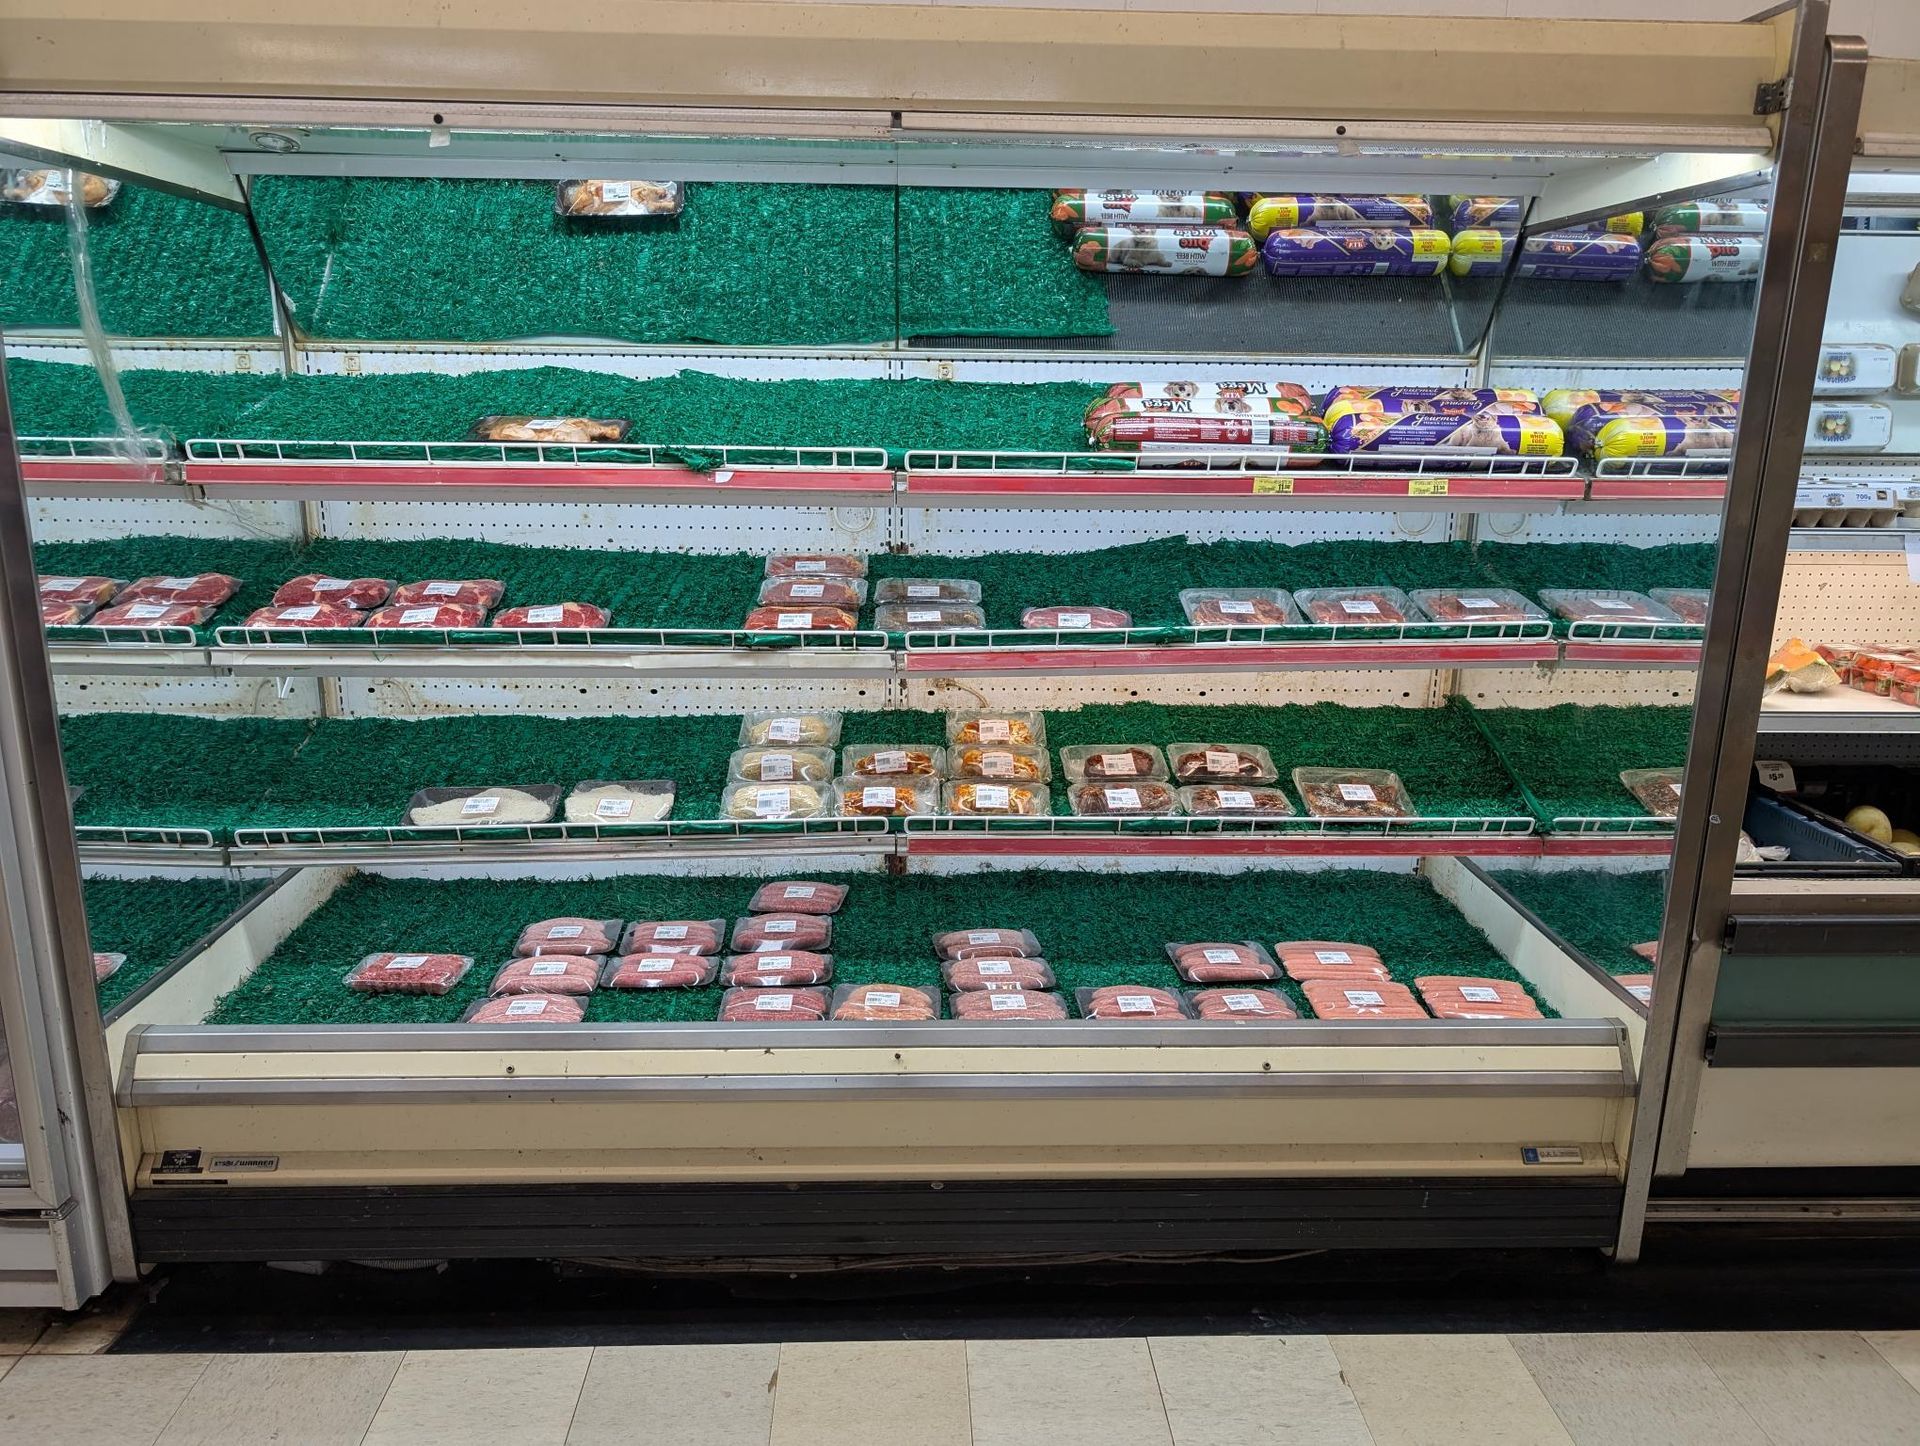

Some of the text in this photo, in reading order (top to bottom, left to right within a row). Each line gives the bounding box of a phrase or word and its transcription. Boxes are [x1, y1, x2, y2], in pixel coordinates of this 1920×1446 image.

[1216, 382, 1267, 394] Mega
[1391, 387, 1438, 397] Gourmet
[1143, 399, 1192, 412] Mega
[1412, 414, 1460, 427] Gourmet
